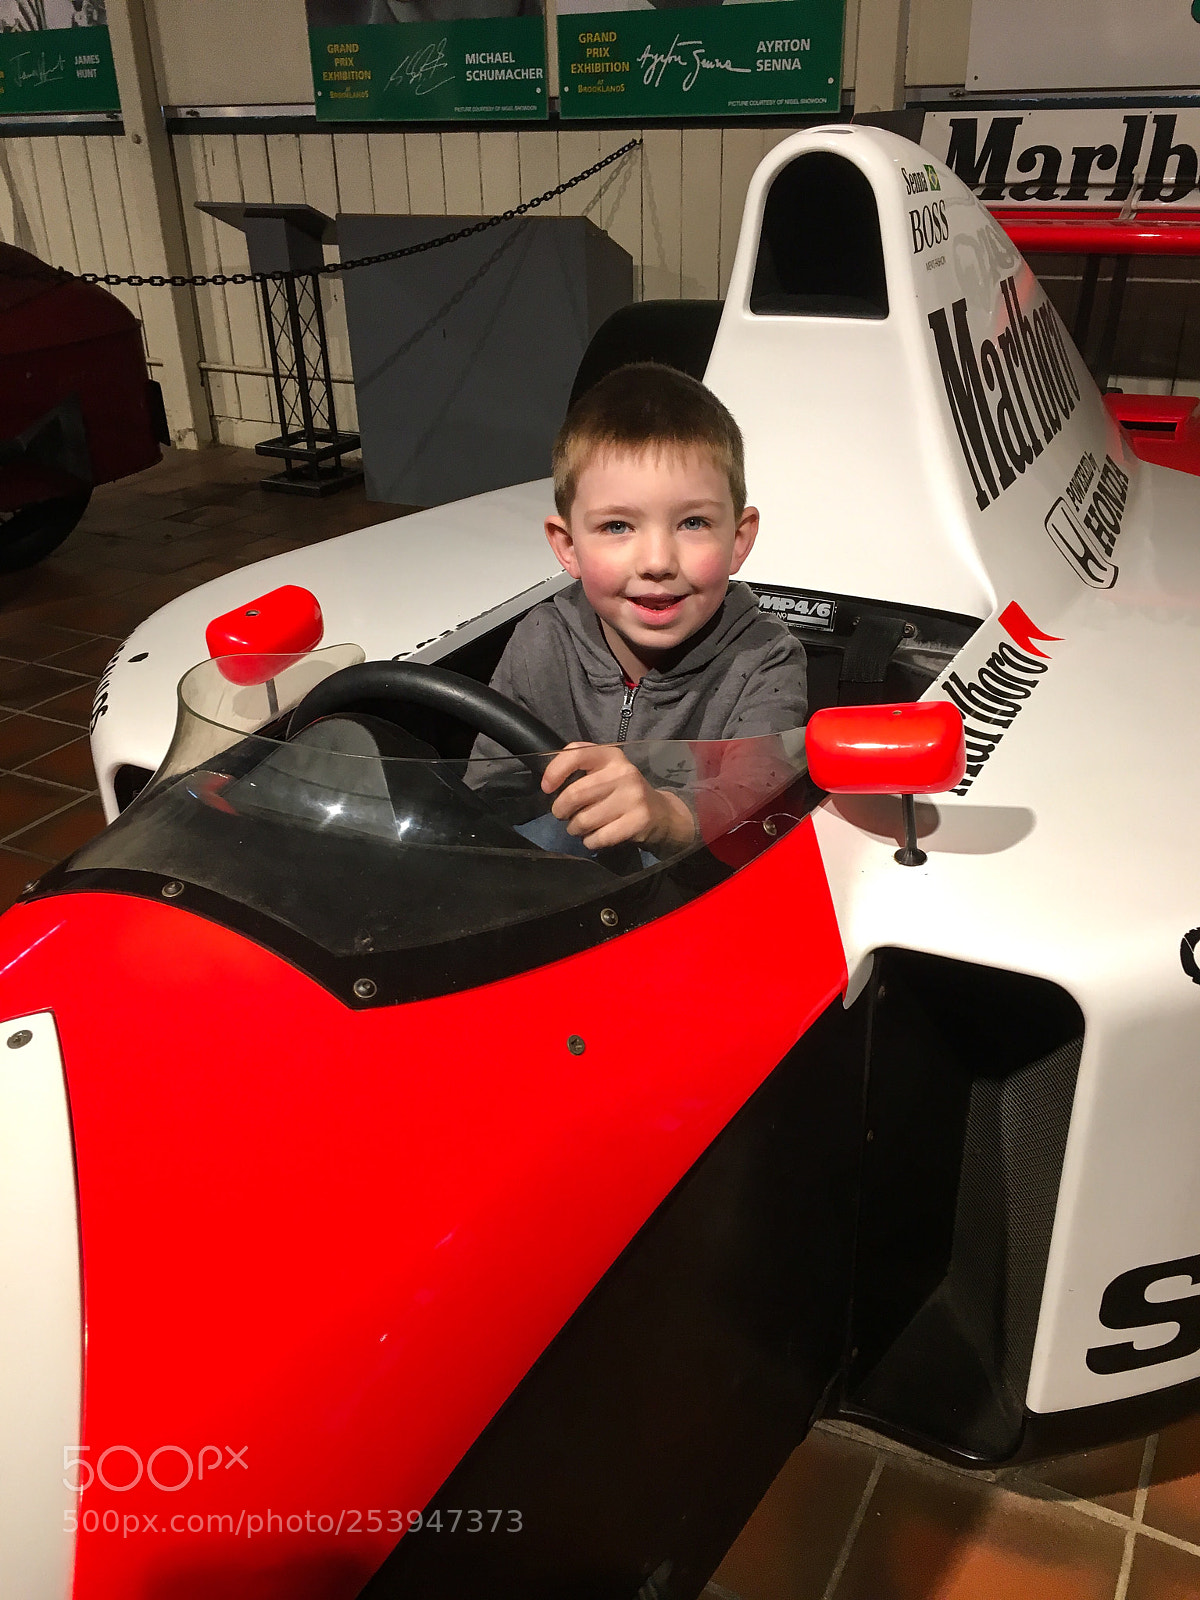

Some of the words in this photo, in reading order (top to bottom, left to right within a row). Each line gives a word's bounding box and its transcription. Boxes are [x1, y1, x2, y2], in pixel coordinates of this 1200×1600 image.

[578, 31, 618, 44] GRAND
[326, 43, 360, 54] GRAND
[756, 38, 811, 53] AYRTON
[465, 52, 516, 65] MICHAEL
[586, 47, 611, 58] PRIX
[74, 54, 101, 65] JAMES
[334, 57, 355, 67] PRIX
[756, 58, 802, 72] SENNA
[76, 68, 98, 79] HUNT
[570, 61, 631, 74] EXHIBITION
[322, 70, 372, 81] EXHIBITION
[465, 68, 544, 82] SCHUMACHER
[945, 114, 1200, 202] Marlb
[900, 167, 929, 195] Senna
[908, 199, 949, 254] BOSS
[927, 275, 1081, 512] Marlboro
[1083, 453, 1130, 558] HONDA
[758, 594, 832, 618] MP4/6
